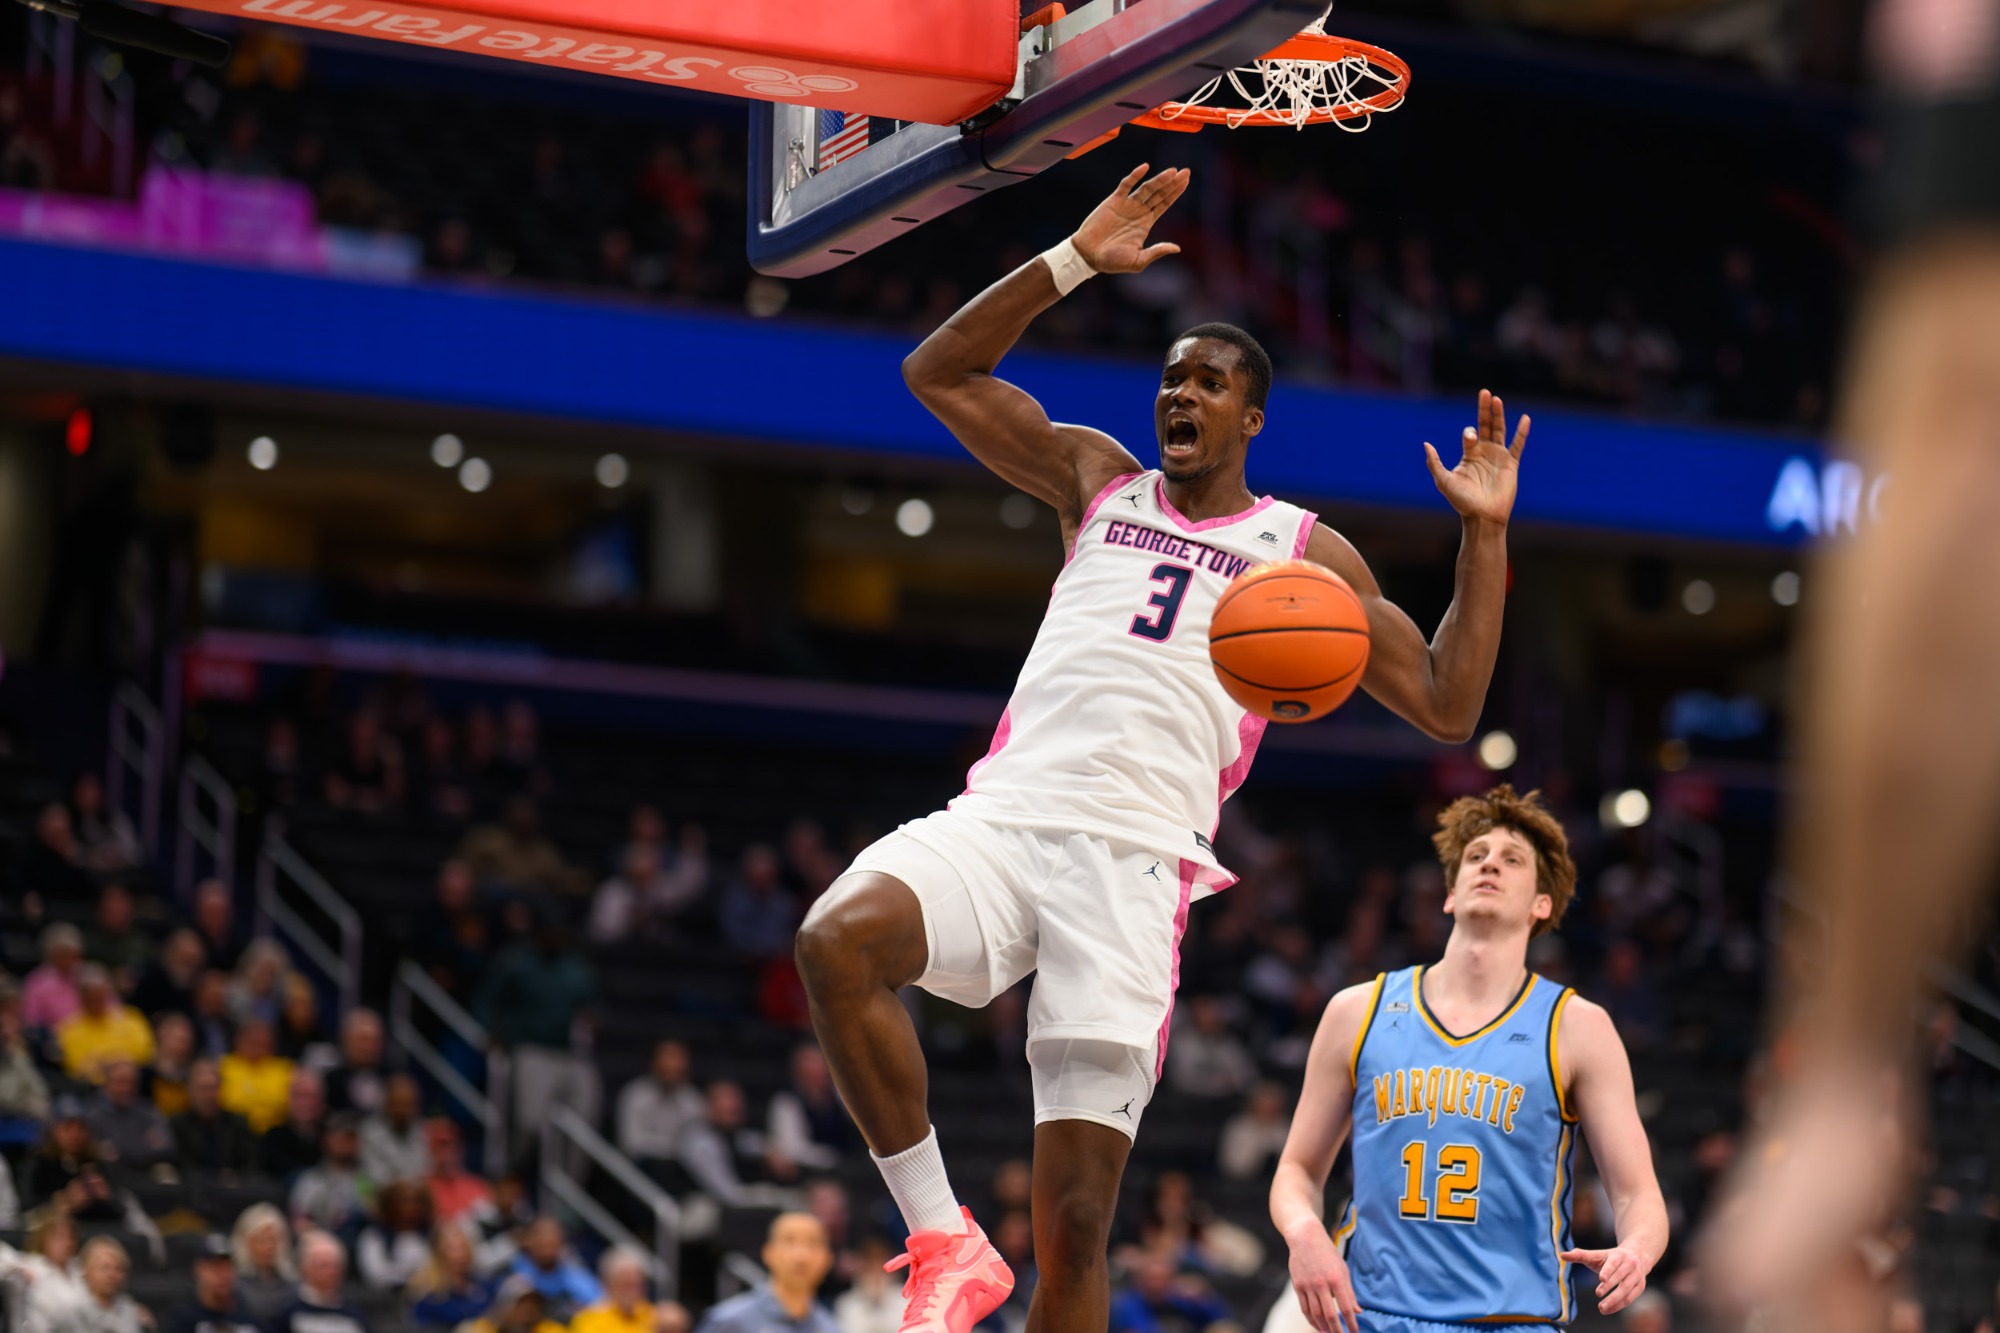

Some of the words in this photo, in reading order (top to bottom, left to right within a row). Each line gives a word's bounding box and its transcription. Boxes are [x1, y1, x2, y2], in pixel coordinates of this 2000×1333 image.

[1103, 520, 1254, 581] GEORGETOW
[1128, 562, 1194, 643] 3
[1373, 1065, 1526, 1134] MARQUETTE
[1398, 1140, 1483, 1225] 12
